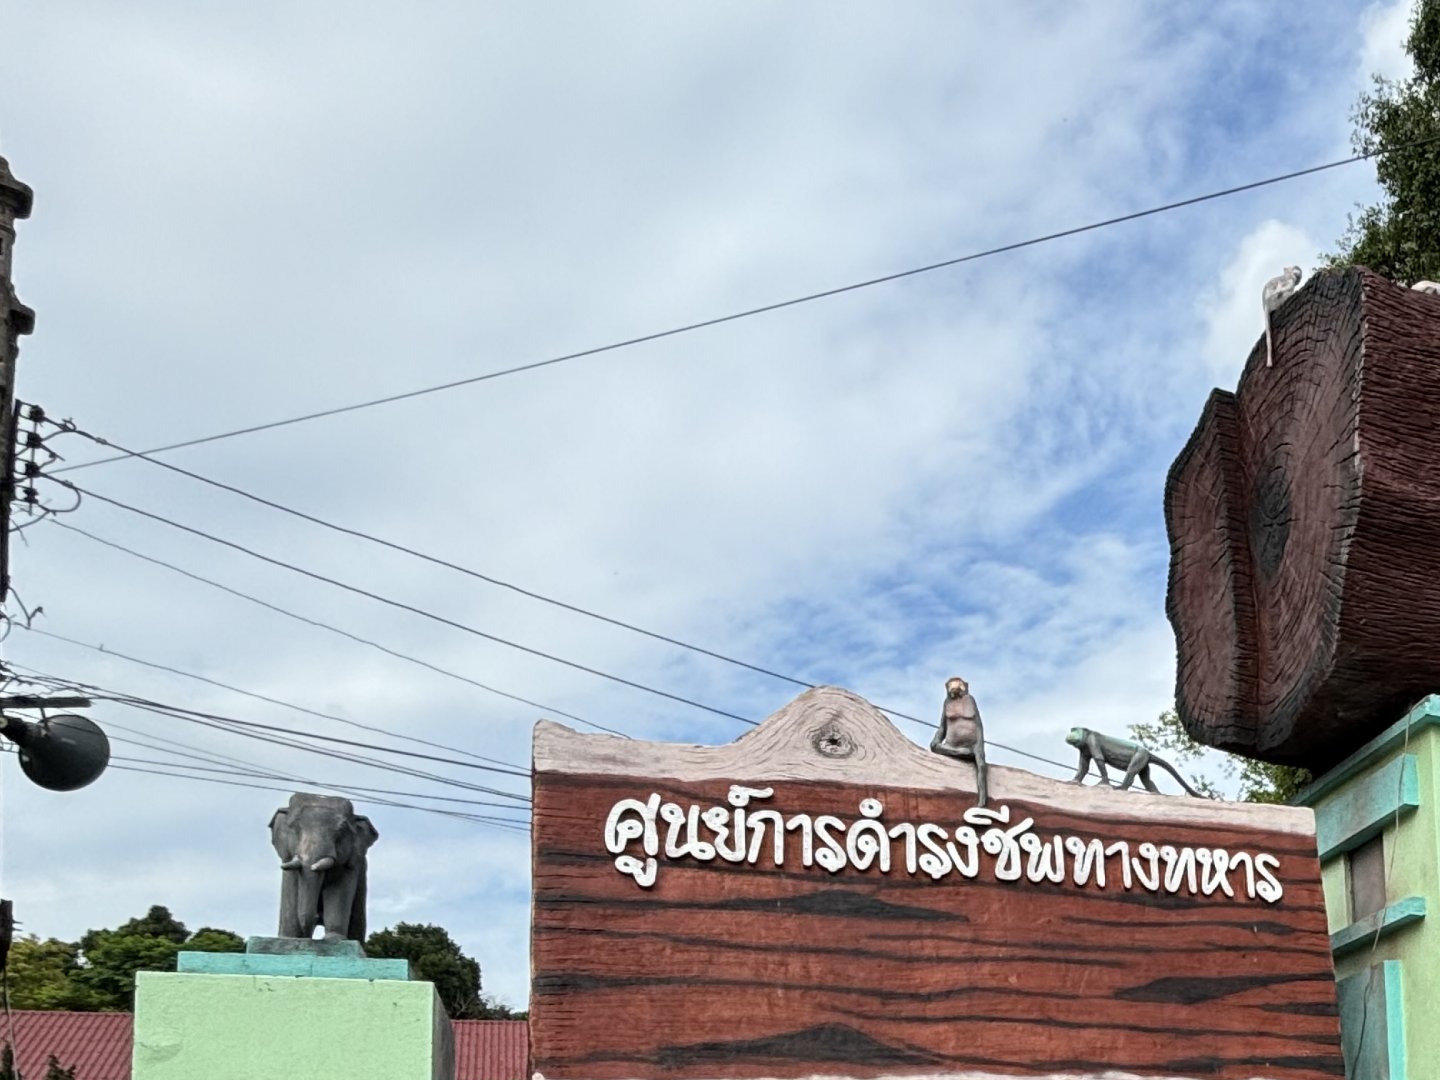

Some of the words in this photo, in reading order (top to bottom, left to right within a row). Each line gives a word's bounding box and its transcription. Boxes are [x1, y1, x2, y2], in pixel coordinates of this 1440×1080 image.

[604, 785, 1284, 903] ศูนย์การดำรงชีพทางทหาร
